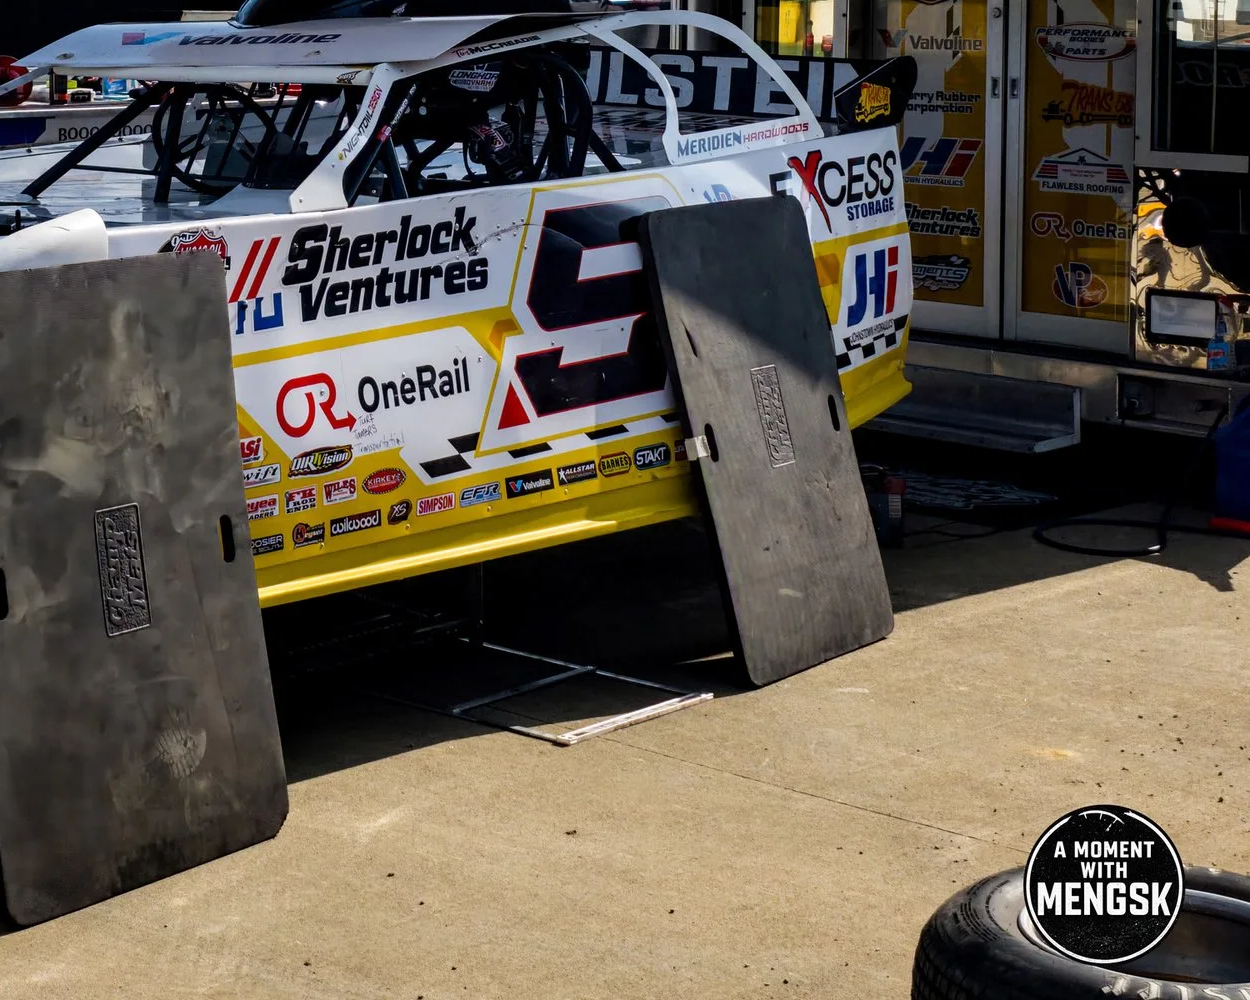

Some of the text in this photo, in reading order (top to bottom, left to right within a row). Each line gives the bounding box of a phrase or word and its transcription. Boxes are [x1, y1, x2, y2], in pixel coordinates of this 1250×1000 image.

[910, 35, 982, 50] Valvoline
[1066, 48, 1106, 56] PARTS
[935, 91, 981, 103] Rubber
[907, 102, 973, 114] orporation
[677, 122, 810, 157] MERIDIEN HARDWOODS
[1042, 181, 1124, 194] FLAWLESS ROOFING
[847, 196, 894, 221] STORAGE
[1073, 220, 1132, 239] OneRai
[281, 206, 478, 286] Sherlock
[299, 257, 489, 322] Ventures
[358, 357, 470, 412] OneRail
[565, 463, 595, 475] ALLSTAR
[601, 456, 629, 471] BARNES
[636, 446, 666, 466] STAKT
[367, 474, 396, 486] KIRKEY
[290, 488, 316, 501] FK
[324, 479, 356, 501] WILES
[418, 494, 453, 514] SIMPSON
[523, 478, 551, 490] Valvoline
[248, 511, 274, 520] ADERS
[287, 504, 316, 514] ENDS
[331, 511, 379, 535] wilwood
[251, 535, 283, 548] OSIER
